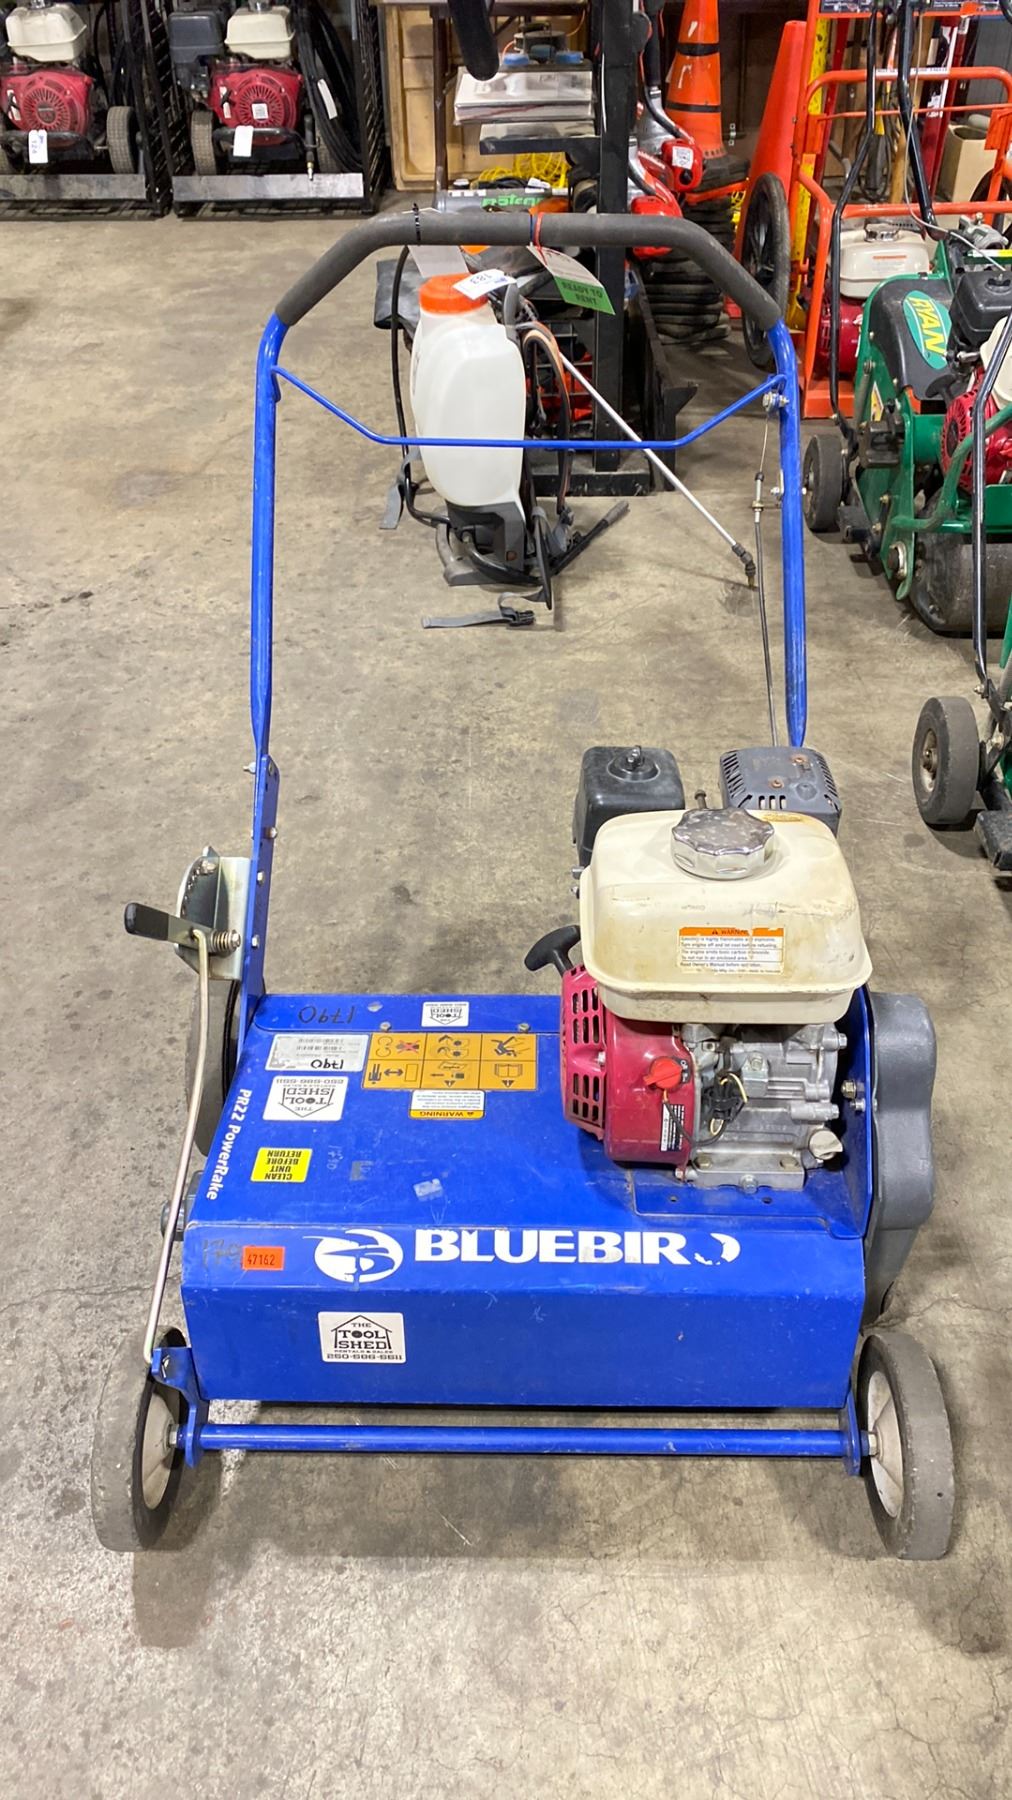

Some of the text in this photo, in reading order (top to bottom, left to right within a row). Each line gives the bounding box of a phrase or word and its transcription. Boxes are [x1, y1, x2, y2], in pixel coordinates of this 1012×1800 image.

[561, 281, 603, 298] READY TO
[575, 293, 597, 305] RENT
[906, 297, 947, 357] RYAN
[310, 1058, 344, 1070] 1790
[286, 1087, 330, 1095] SHED
[285, 1096, 327, 1104] TOOL
[206, 1088, 253, 1200] PR22 PowerRake
[247, 1254, 276, 1266] 47162
[338, 1330, 386, 1339] TOOL
[338, 1340, 387, 1349] SHED
